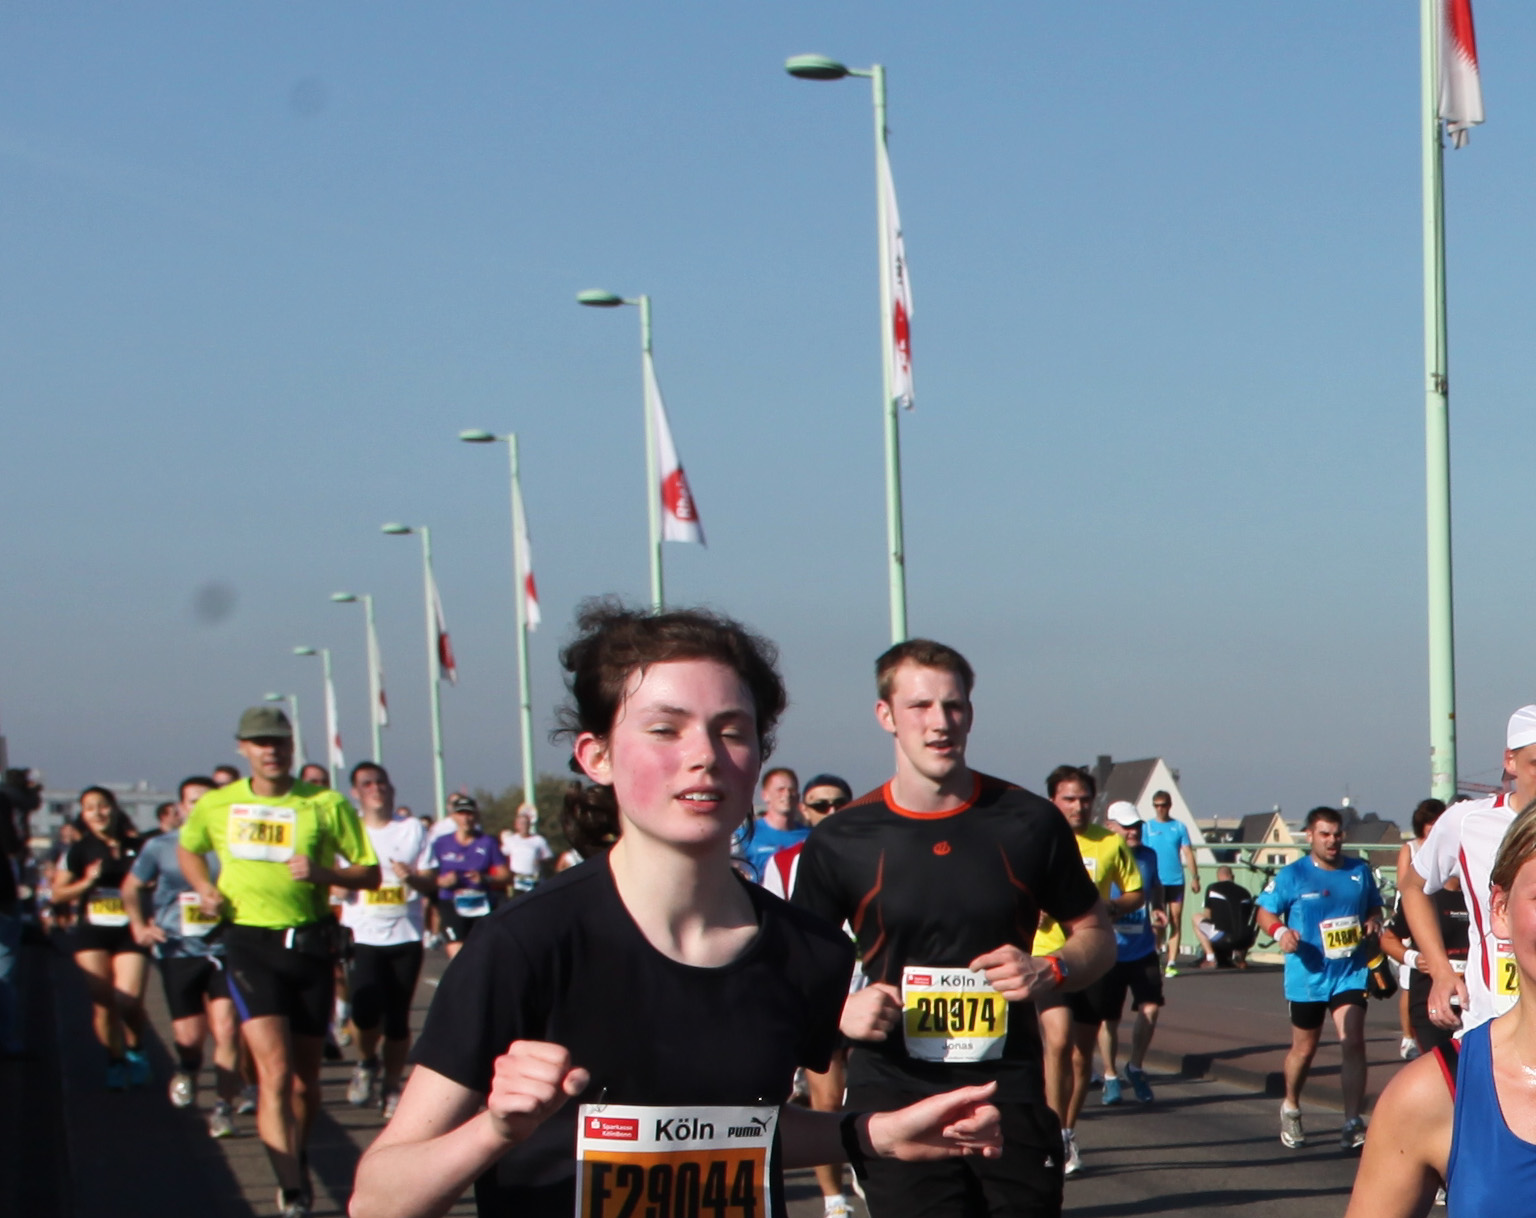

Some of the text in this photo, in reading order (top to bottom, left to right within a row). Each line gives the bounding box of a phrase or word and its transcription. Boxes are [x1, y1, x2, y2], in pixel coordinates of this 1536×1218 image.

[940, 975, 976, 987] Köln
[917, 998, 996, 1032] 20974
[942, 1042, 974, 1050] Jonas
[655, 1118, 715, 1141] Köln
[728, 1126, 762, 1138] PUMA
